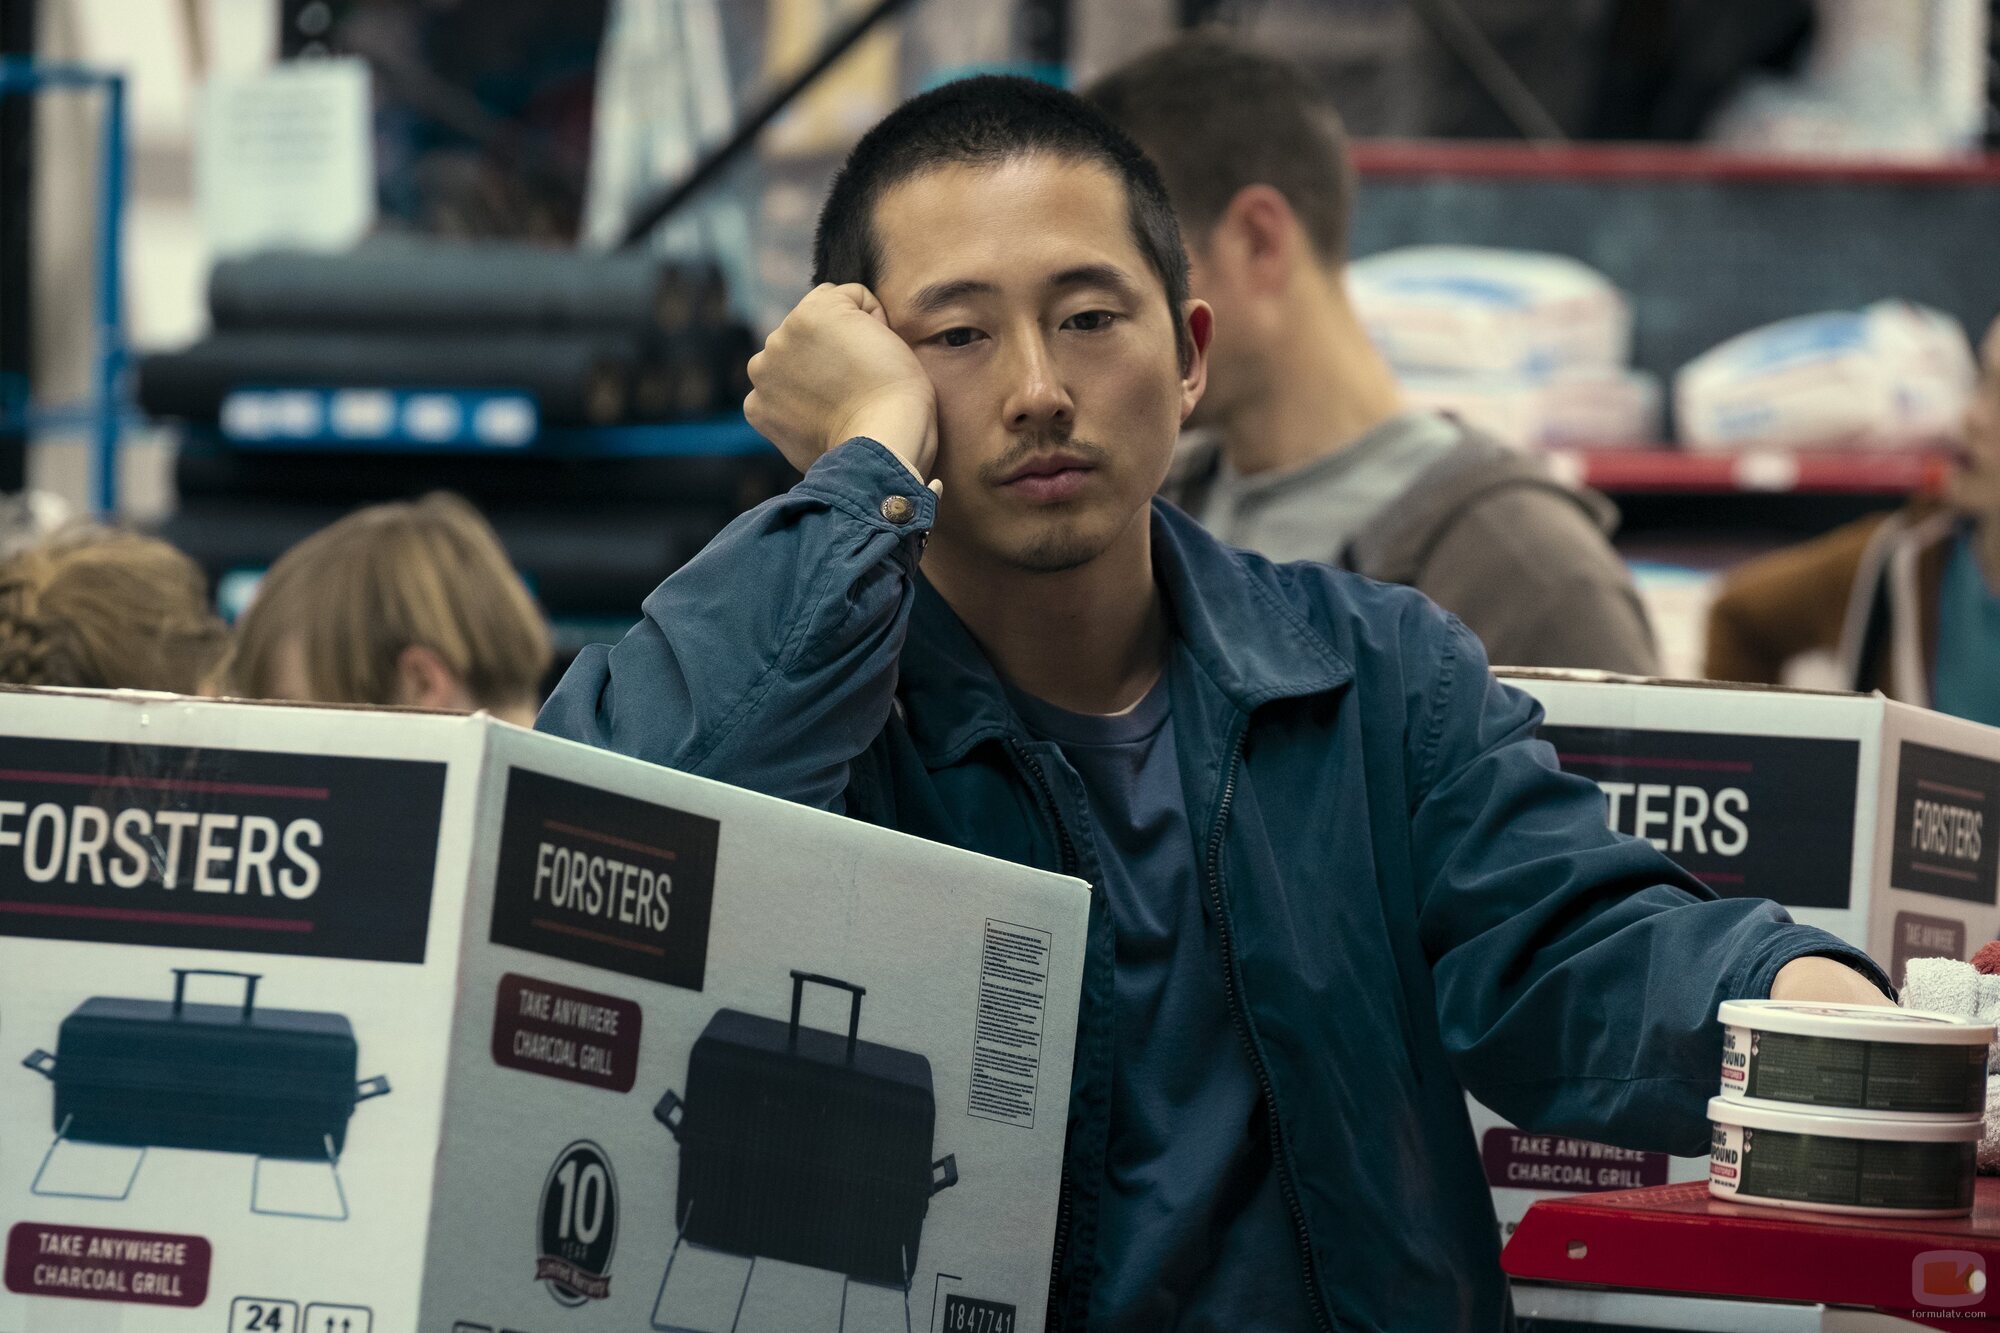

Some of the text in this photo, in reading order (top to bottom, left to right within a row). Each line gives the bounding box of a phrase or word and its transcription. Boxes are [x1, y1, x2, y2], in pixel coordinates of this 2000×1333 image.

[1598, 780, 1750, 857] TERS
[1911, 799, 1983, 862] FORSTERS
[0, 801, 324, 900] FORSTERS
[533, 843, 672, 932] FORSTERS
[519, 989, 620, 1036] TAKE ANYWHERE
[513, 1030, 613, 1076] CHARCOAL GRILL
[1510, 1136, 1550, 1156] TAKE
[1507, 1162, 1644, 1187] CHARCOAL GRILL
[556, 1160, 607, 1244] 10
[38, 1233, 187, 1265] TAKE ANYWHERE
[33, 1264, 183, 1297] CHARCOAL GRILL
[245, 1305, 282, 1332] 24
[949, 1302, 1012, 1333] 1847741
